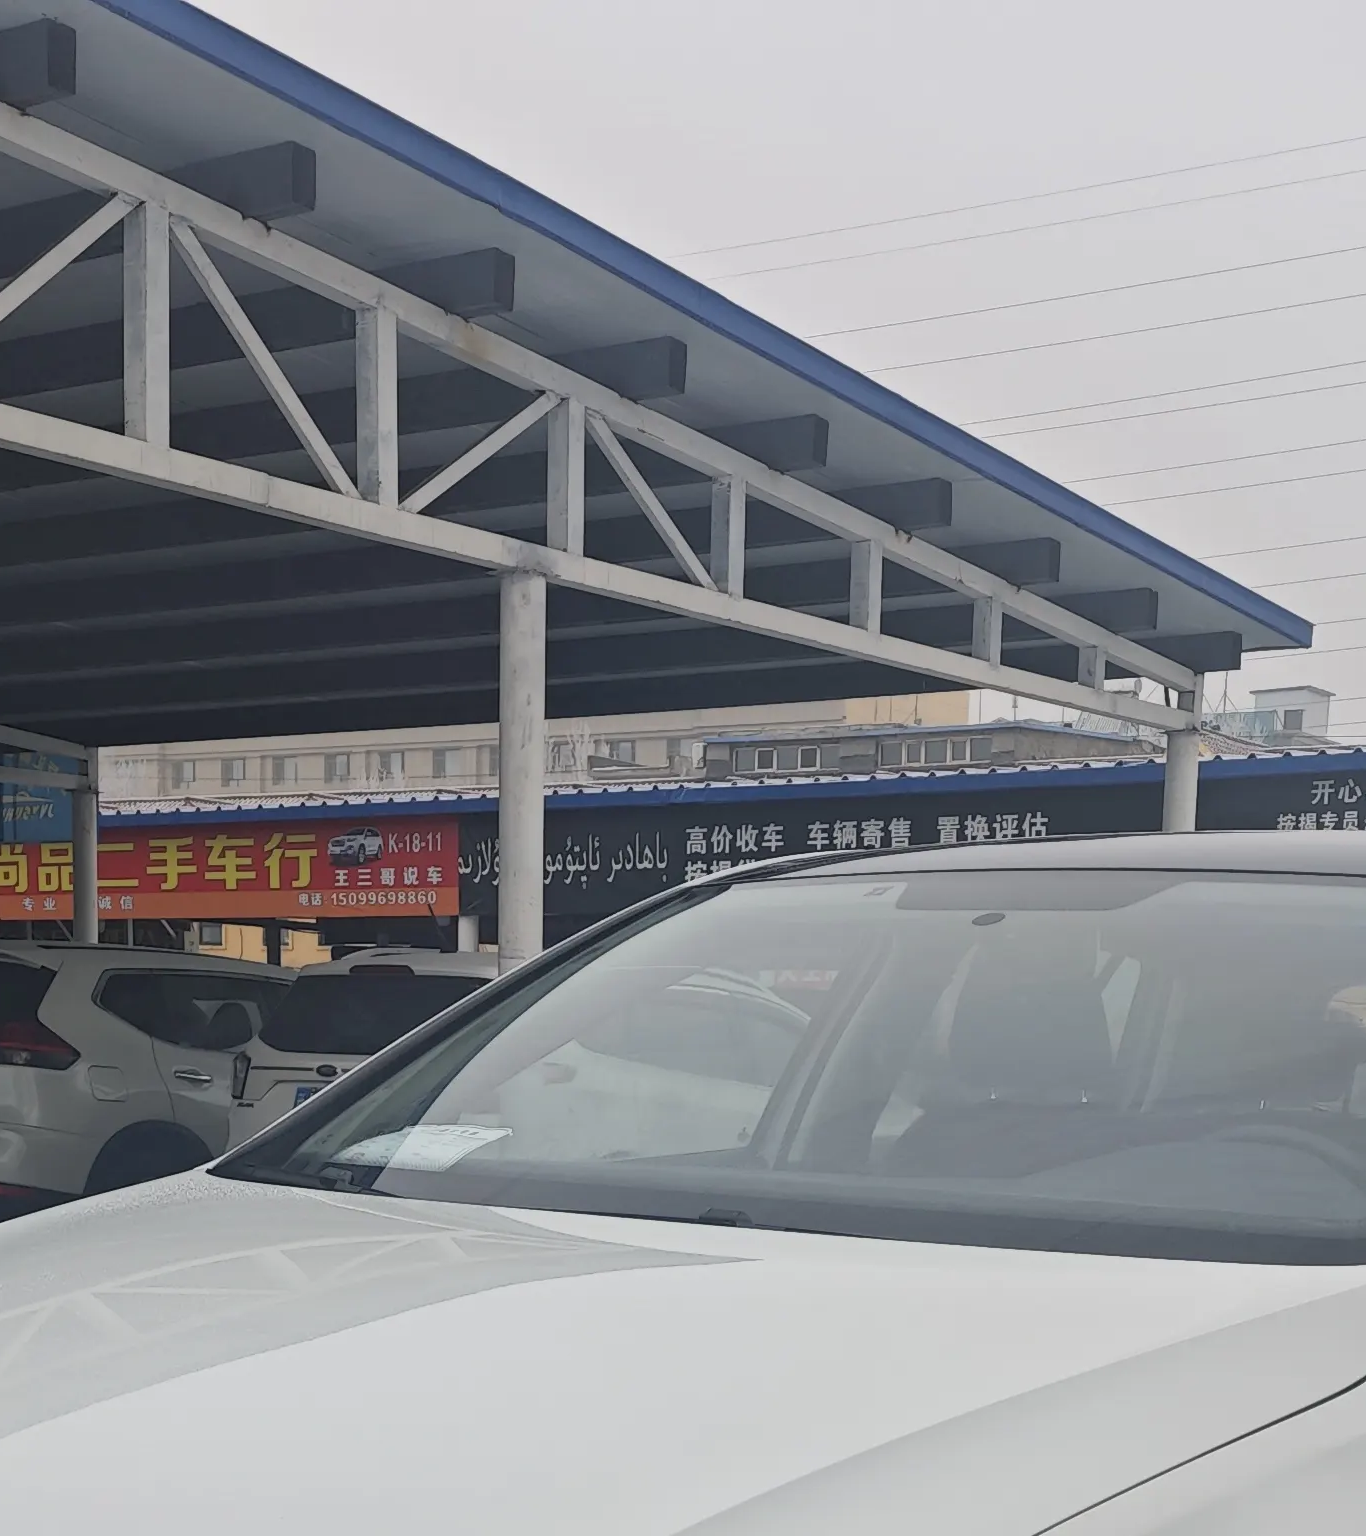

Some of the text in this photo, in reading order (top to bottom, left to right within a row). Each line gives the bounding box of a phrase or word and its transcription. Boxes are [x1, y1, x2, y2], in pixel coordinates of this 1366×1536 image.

[387, 831, 442, 854] K-18-11
[685, 811, 1050, 855] 高价收车 车辆寄售 置换评估
[334, 866, 443, 887] 王三哥说车
